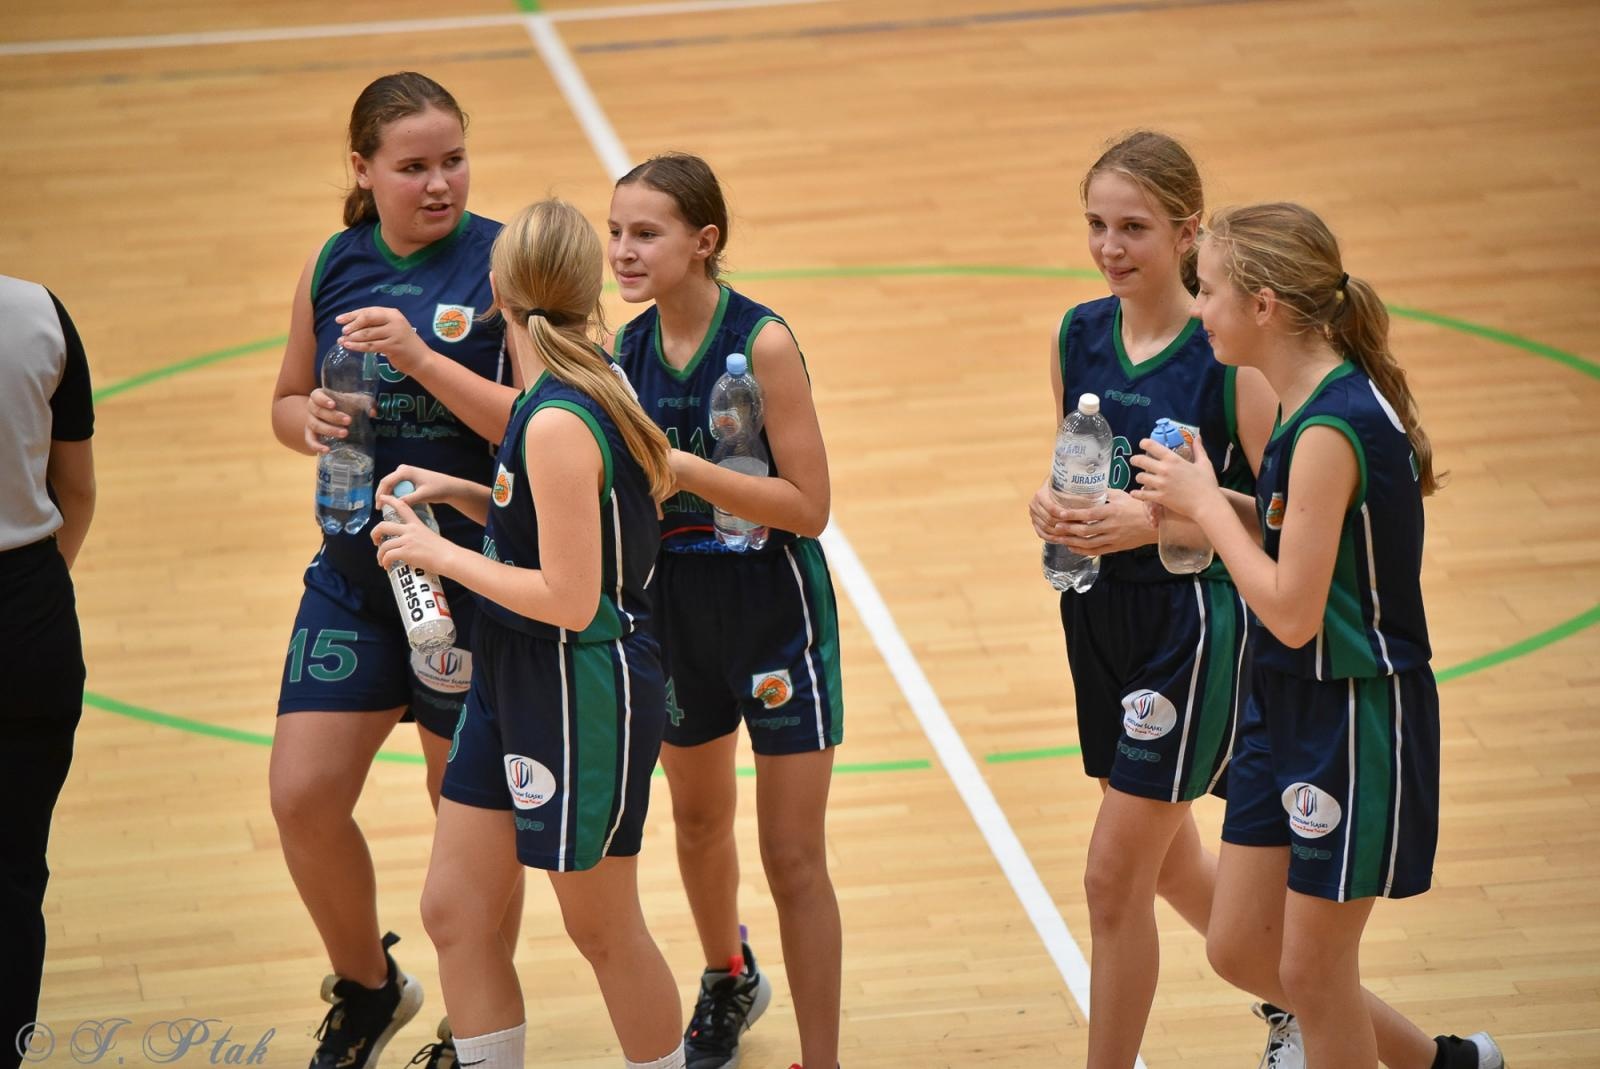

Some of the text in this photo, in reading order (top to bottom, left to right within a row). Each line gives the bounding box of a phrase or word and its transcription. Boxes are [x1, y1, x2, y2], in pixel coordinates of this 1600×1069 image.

[1071, 472, 1106, 484] JURAJSKA
[1108, 435, 1132, 491] 6
[397, 564, 424, 623] OSHEE
[288, 628, 359, 684] 15
